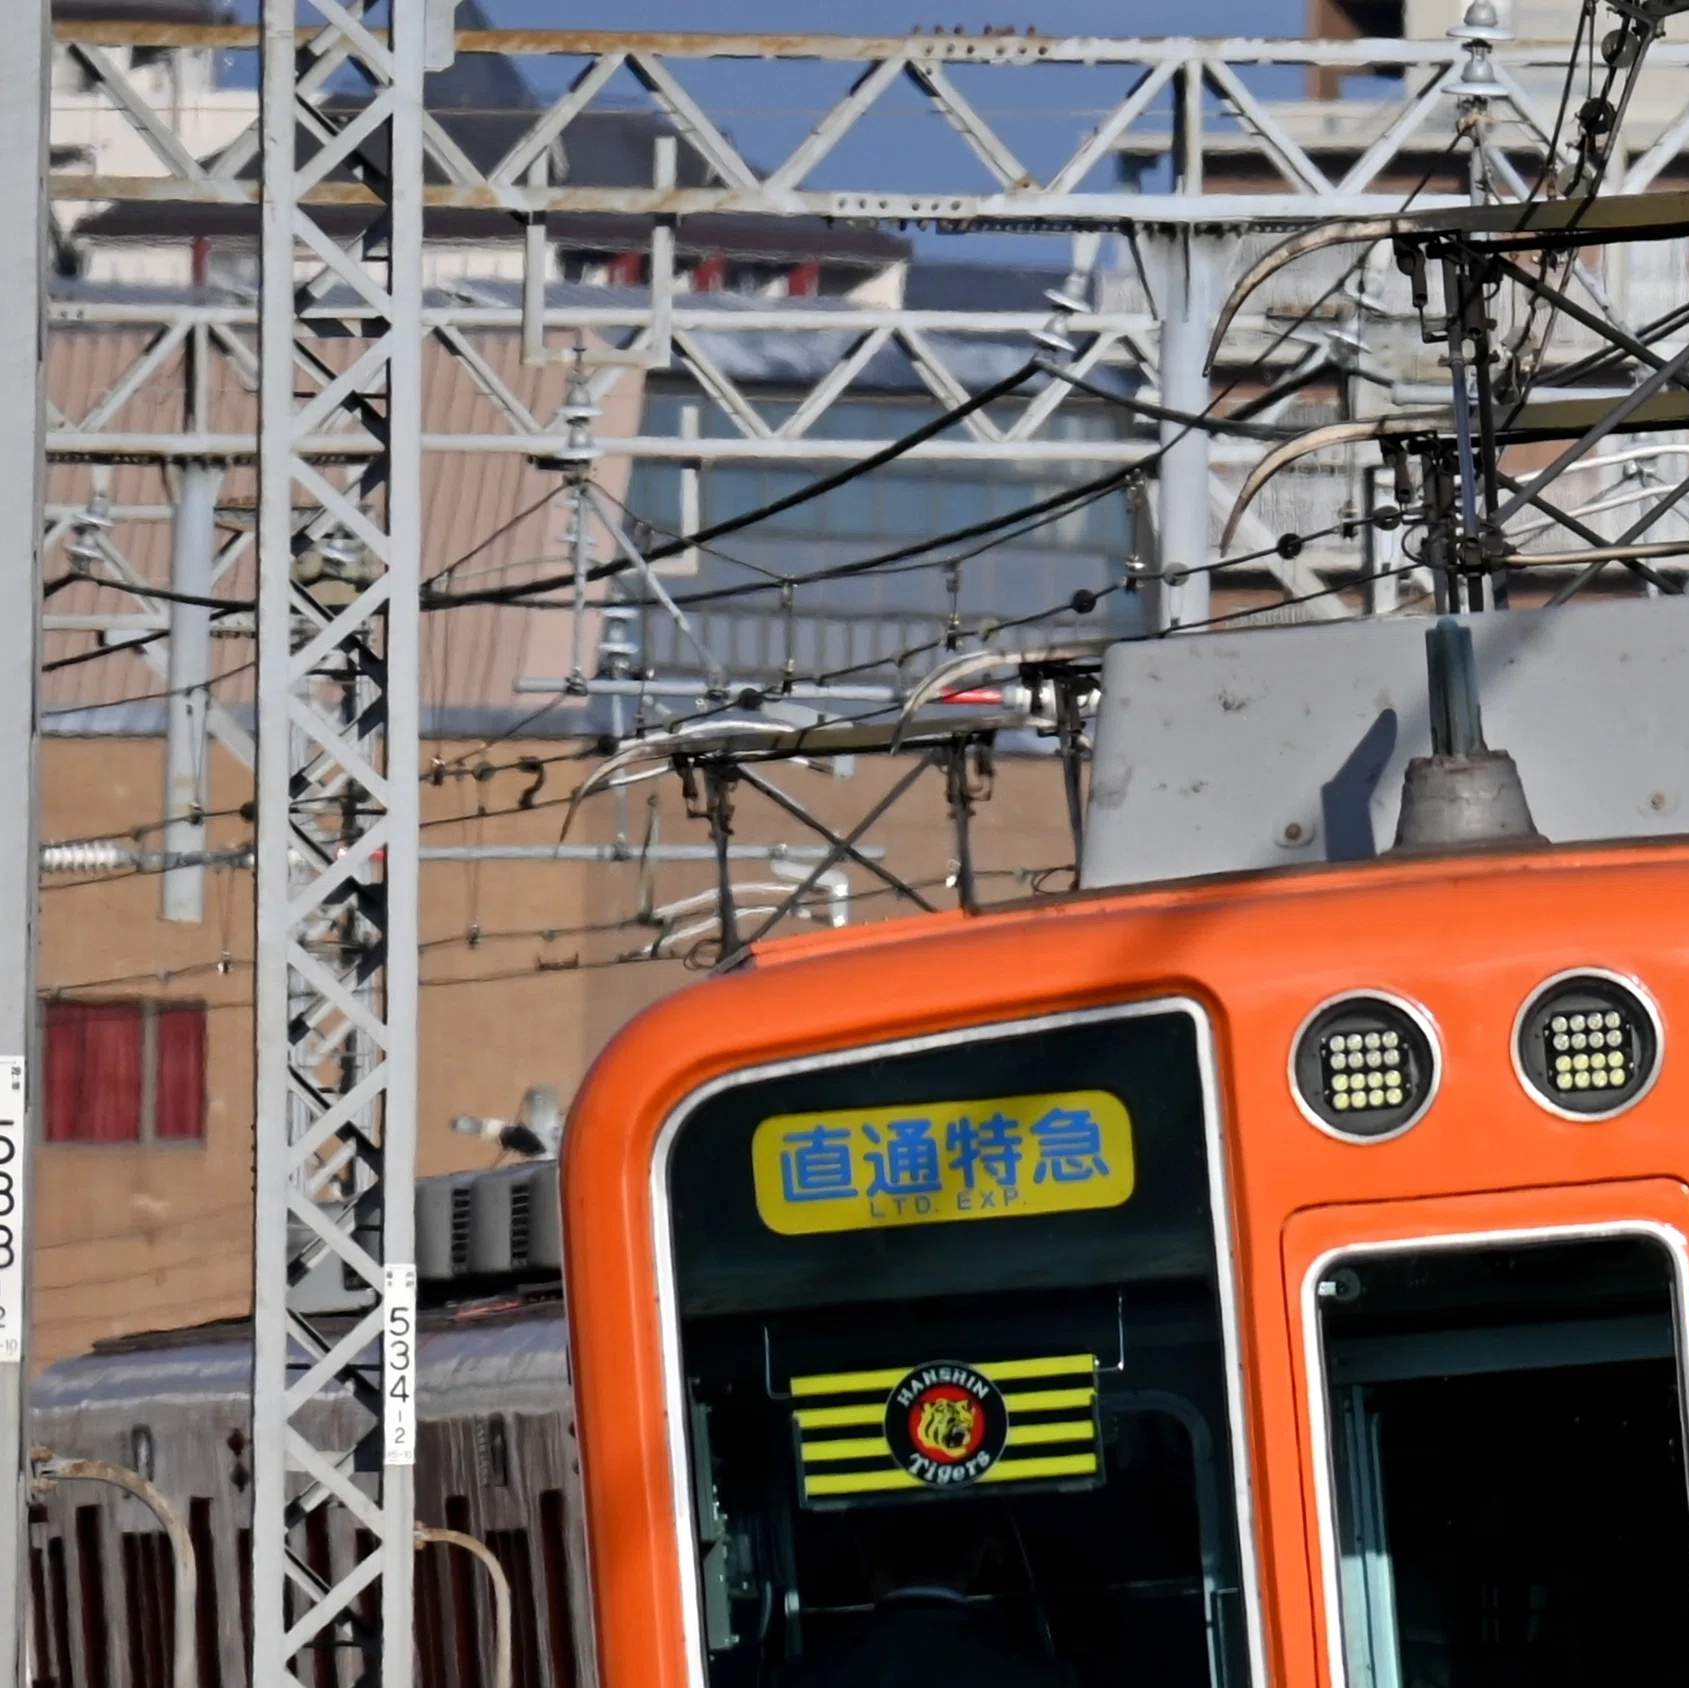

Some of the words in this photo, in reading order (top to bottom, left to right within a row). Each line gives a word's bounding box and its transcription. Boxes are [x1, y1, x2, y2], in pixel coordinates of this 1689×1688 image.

[779, 1106, 1110, 1204] 直通特急
[897, 1367, 990, 1407] HANSHIN
[909, 1451, 991, 1485] Tigers
